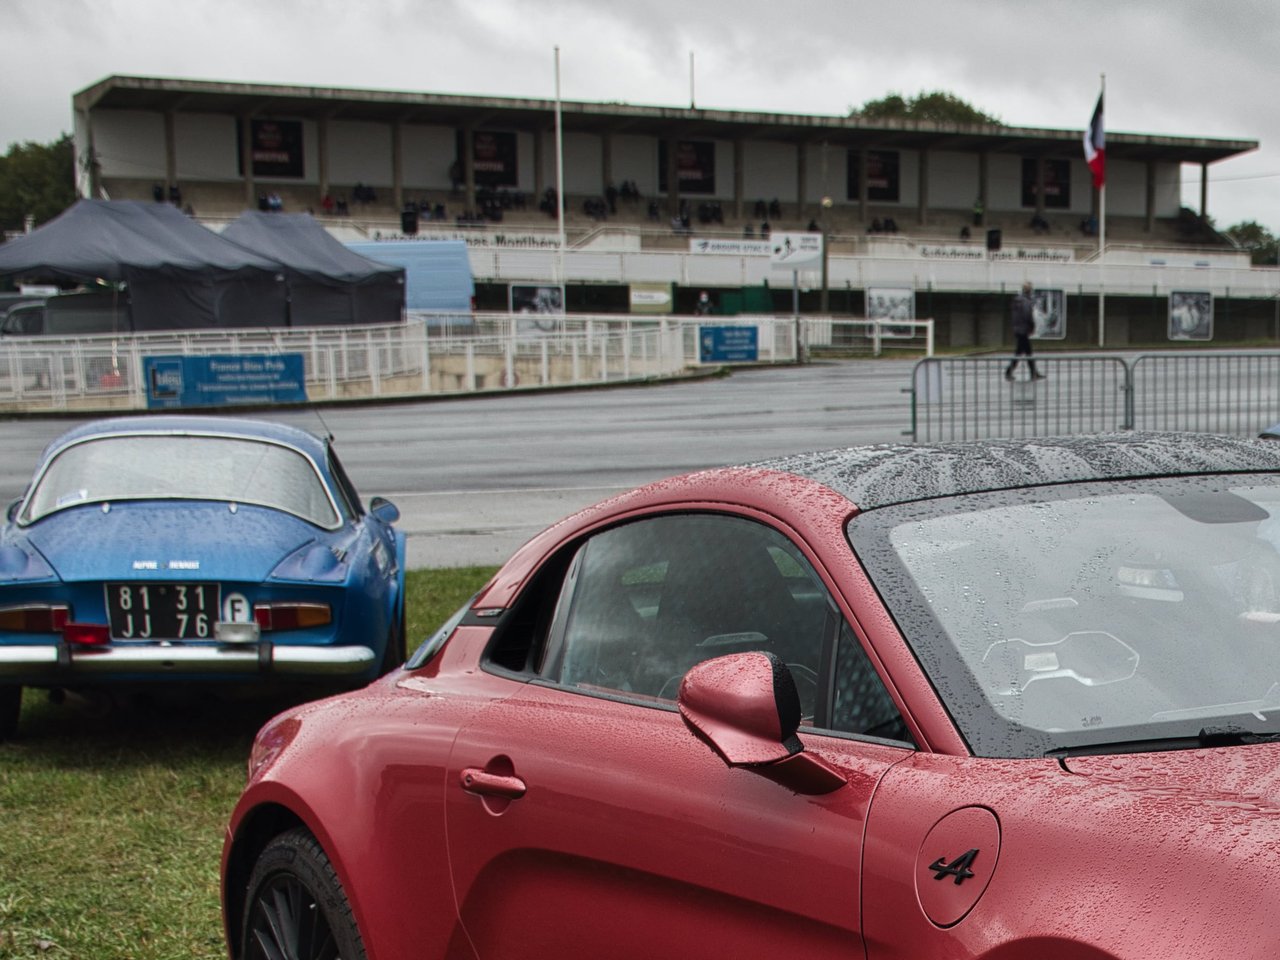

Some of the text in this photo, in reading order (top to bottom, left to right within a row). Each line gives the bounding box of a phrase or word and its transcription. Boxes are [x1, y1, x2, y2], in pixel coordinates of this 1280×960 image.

[120, 586, 205, 610] 81 31
[230, 599, 244, 623] F
[122, 613, 208, 638] JJ 76
